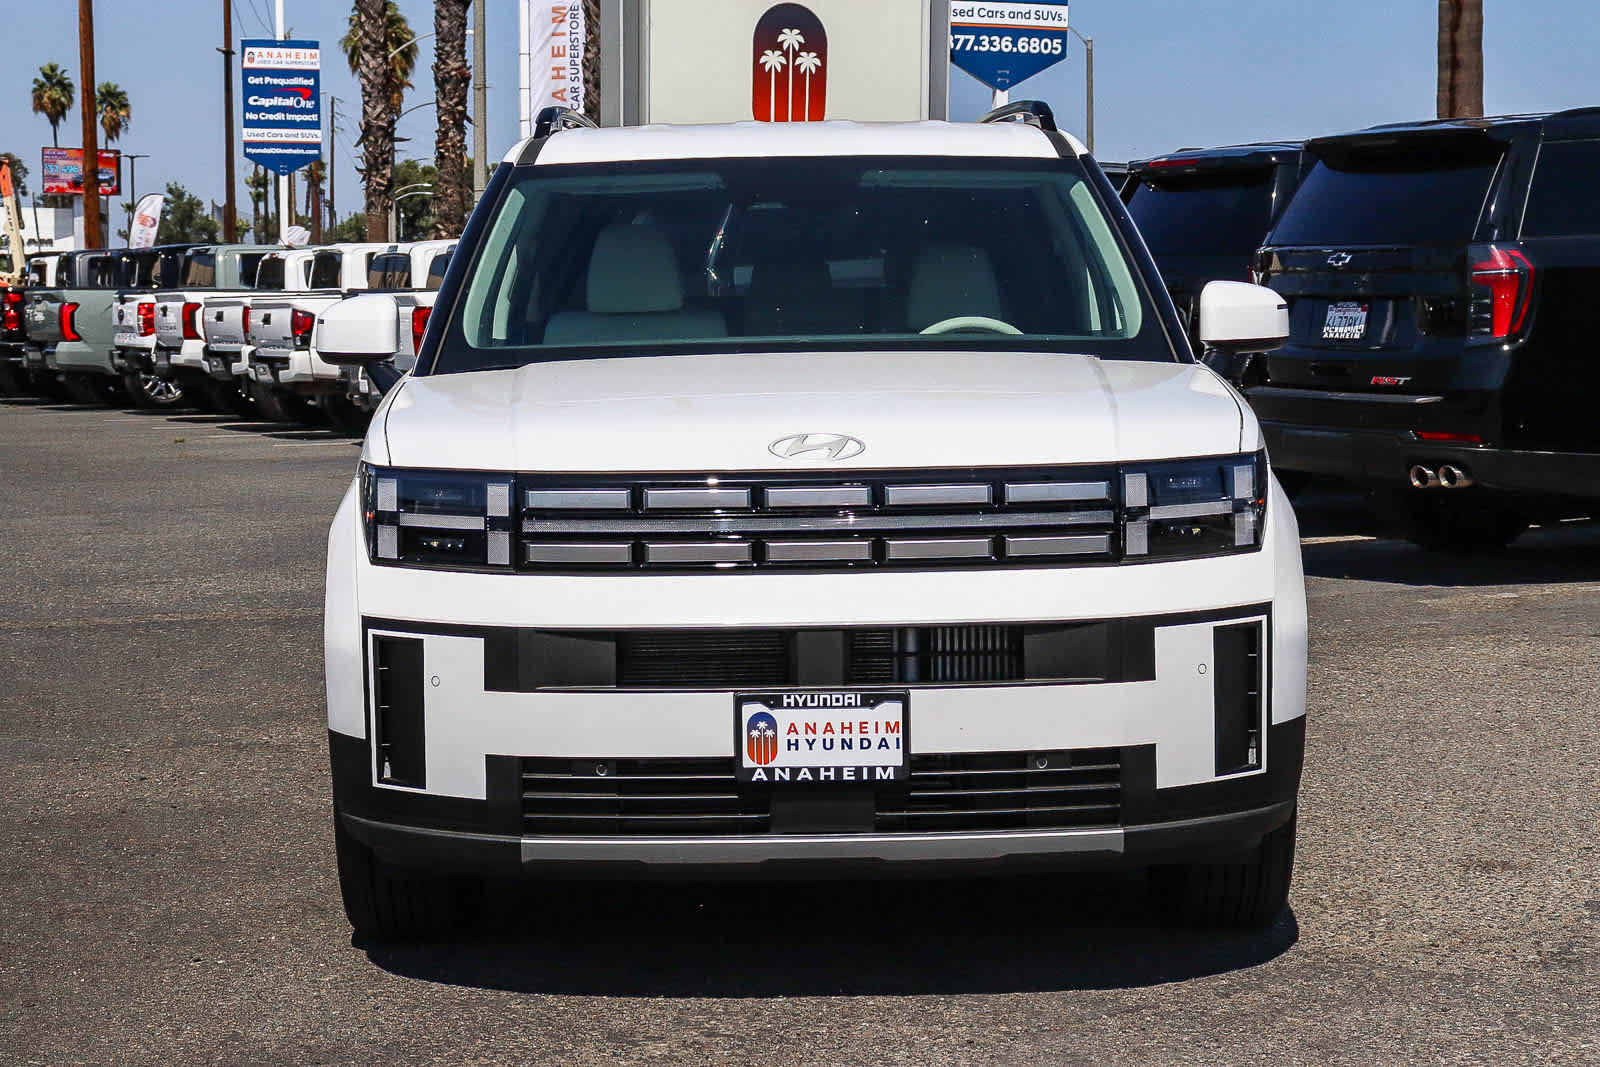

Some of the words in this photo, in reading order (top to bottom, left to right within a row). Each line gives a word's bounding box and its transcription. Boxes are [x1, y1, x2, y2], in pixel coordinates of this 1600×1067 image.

[951, 7, 974, 18] sed
[977, 8, 1006, 19] Cars
[1008, 9, 1032, 20] and
[569, 4, 581, 83] SUPERSTORE
[257, 51, 318, 60] ANAHEIM
[551, 5, 567, 103] AHEIM
[247, 76, 264, 85] Get
[264, 76, 315, 87] Prequalified
[569, 85, 581, 112] CAR
[245, 112, 259, 120] No
[259, 112, 286, 121] Credit
[783, 693, 862, 708] HYUNDAI
[786, 720, 900, 736] ANAHEIM
[786, 736, 901, 752] HYUNDAI
[751, 766, 896, 782] ANAHEIM
